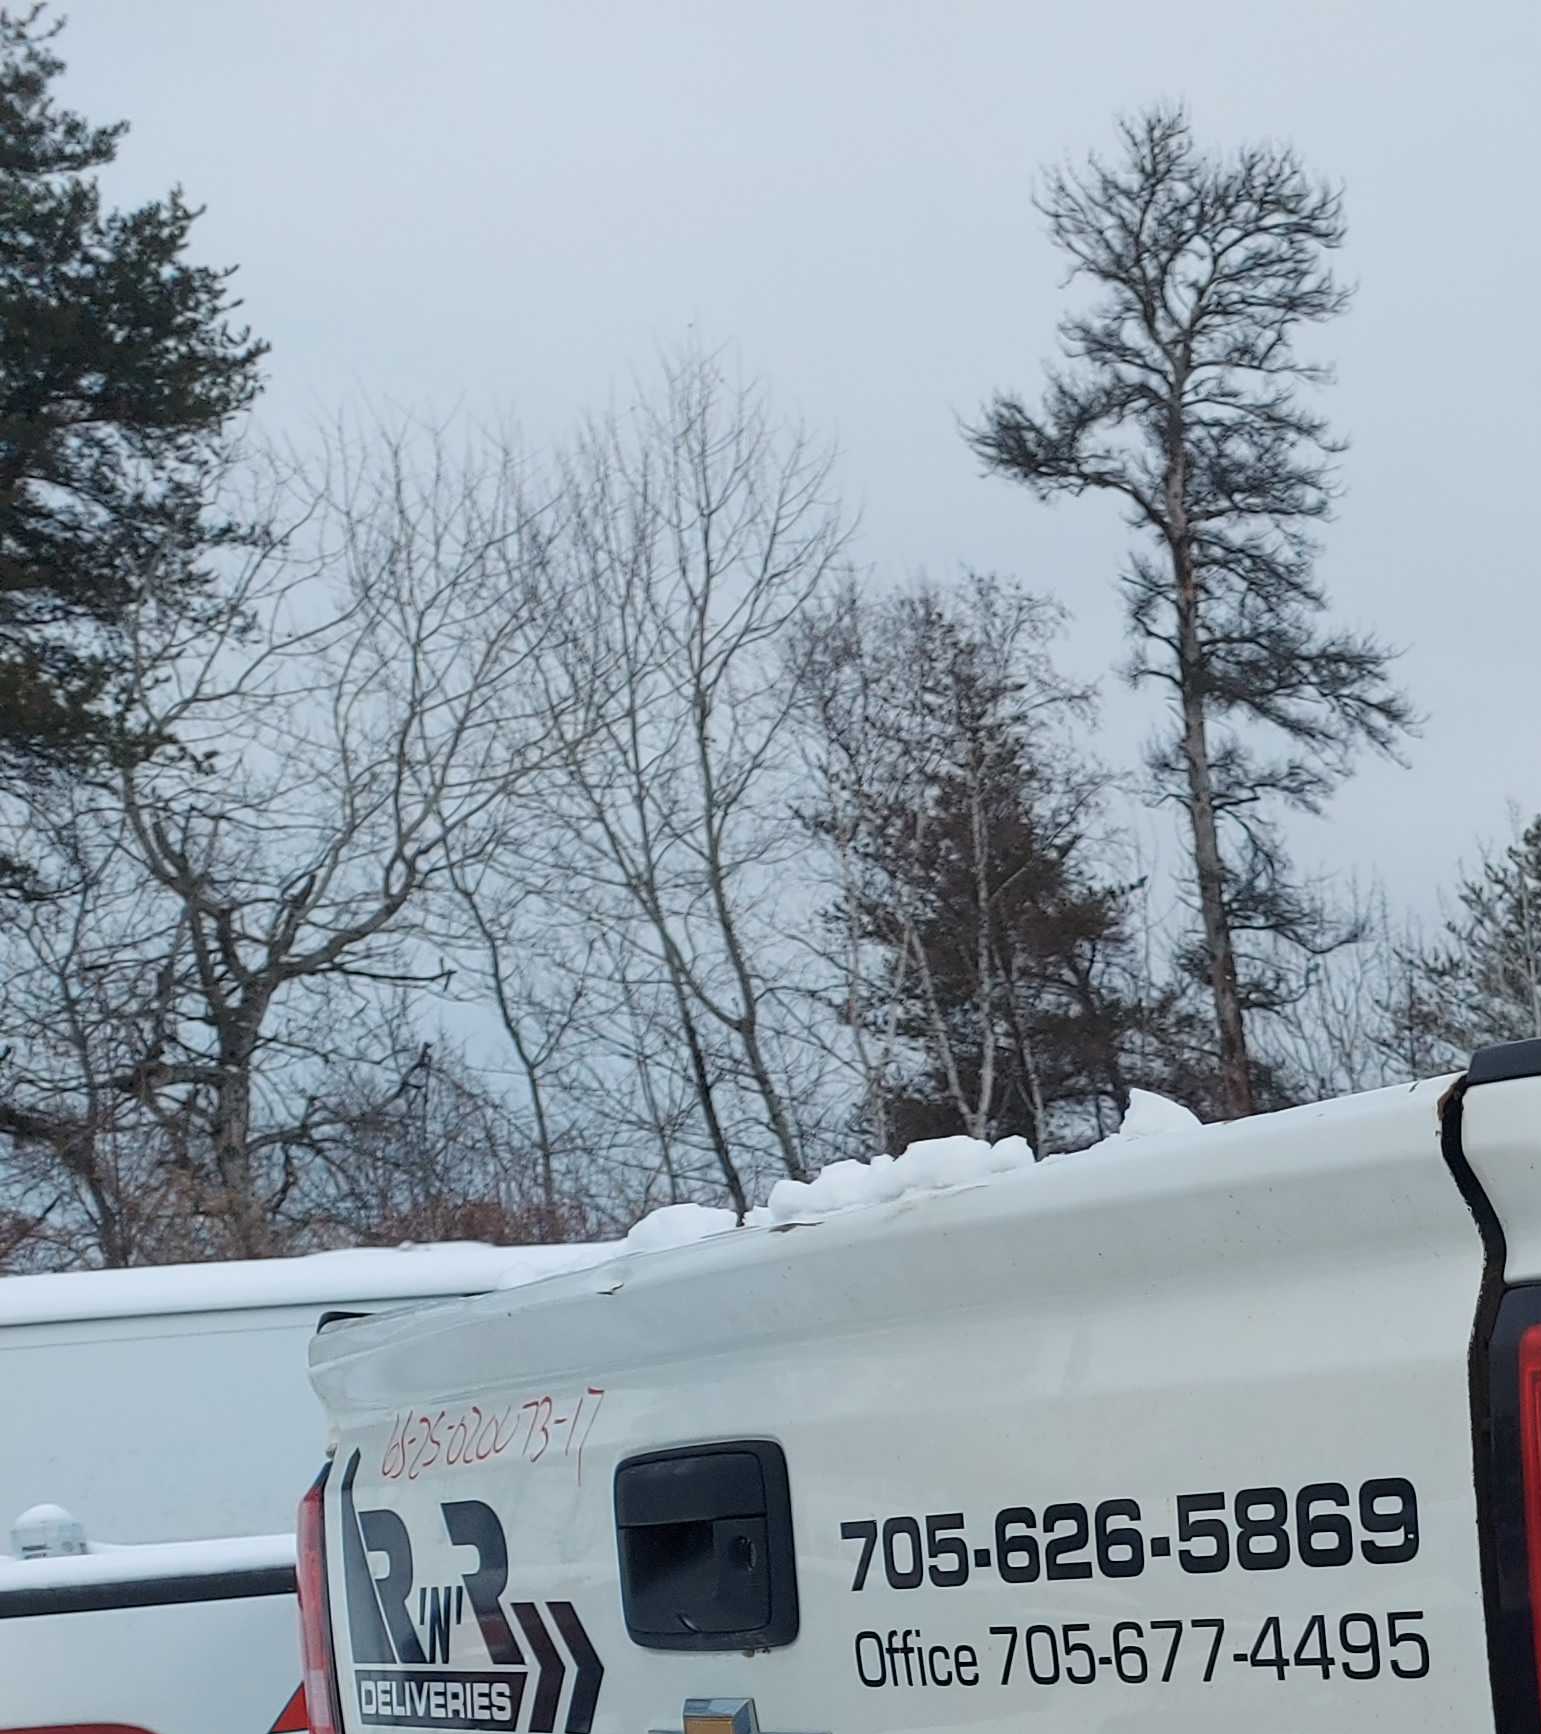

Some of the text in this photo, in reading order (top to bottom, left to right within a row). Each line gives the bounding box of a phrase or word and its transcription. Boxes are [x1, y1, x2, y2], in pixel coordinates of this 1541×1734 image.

[854, 1610, 1431, 1688] Office 705-677-4495
[359, 1678, 513, 1722] DELIVERIES
